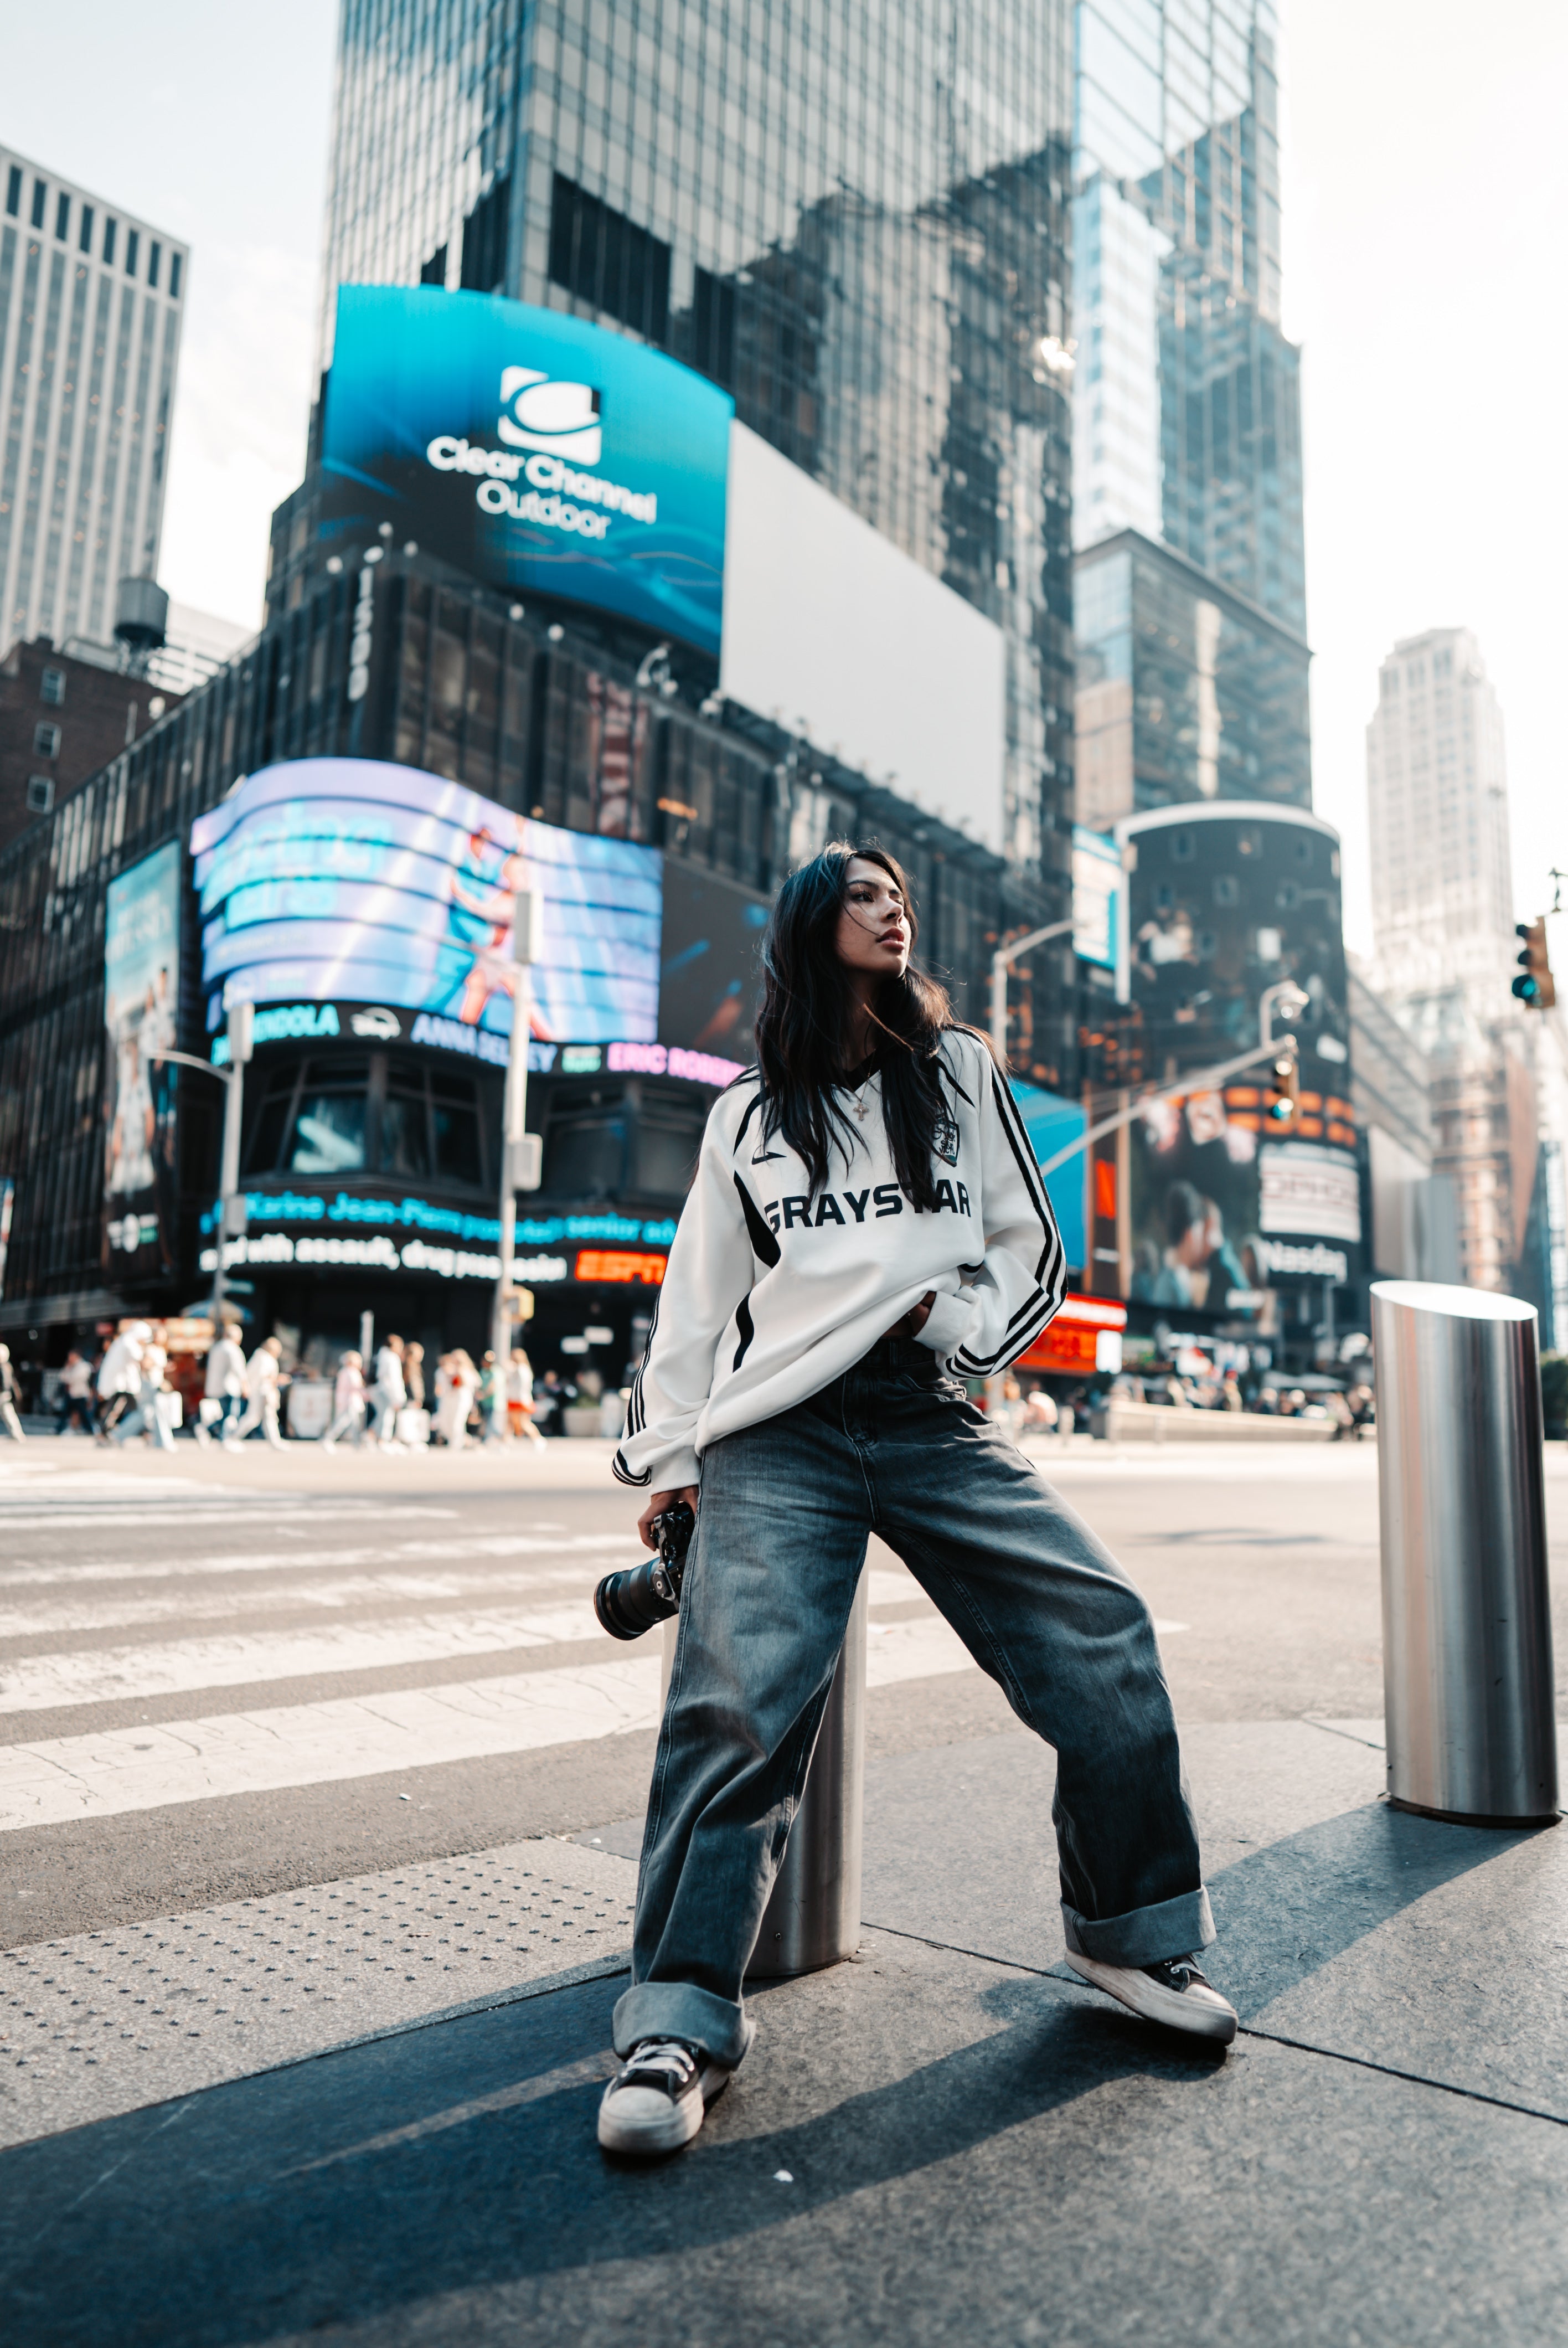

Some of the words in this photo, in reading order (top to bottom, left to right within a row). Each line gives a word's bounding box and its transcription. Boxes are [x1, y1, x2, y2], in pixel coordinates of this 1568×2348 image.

[427, 435, 525, 481] Clear
[524, 455, 657, 525] Channel
[476, 478, 611, 540] Outdoor
[607, 1041, 668, 1075] ERIC
[455, 1250, 567, 1281] possssion
[575, 1249, 668, 1284] ESPN
